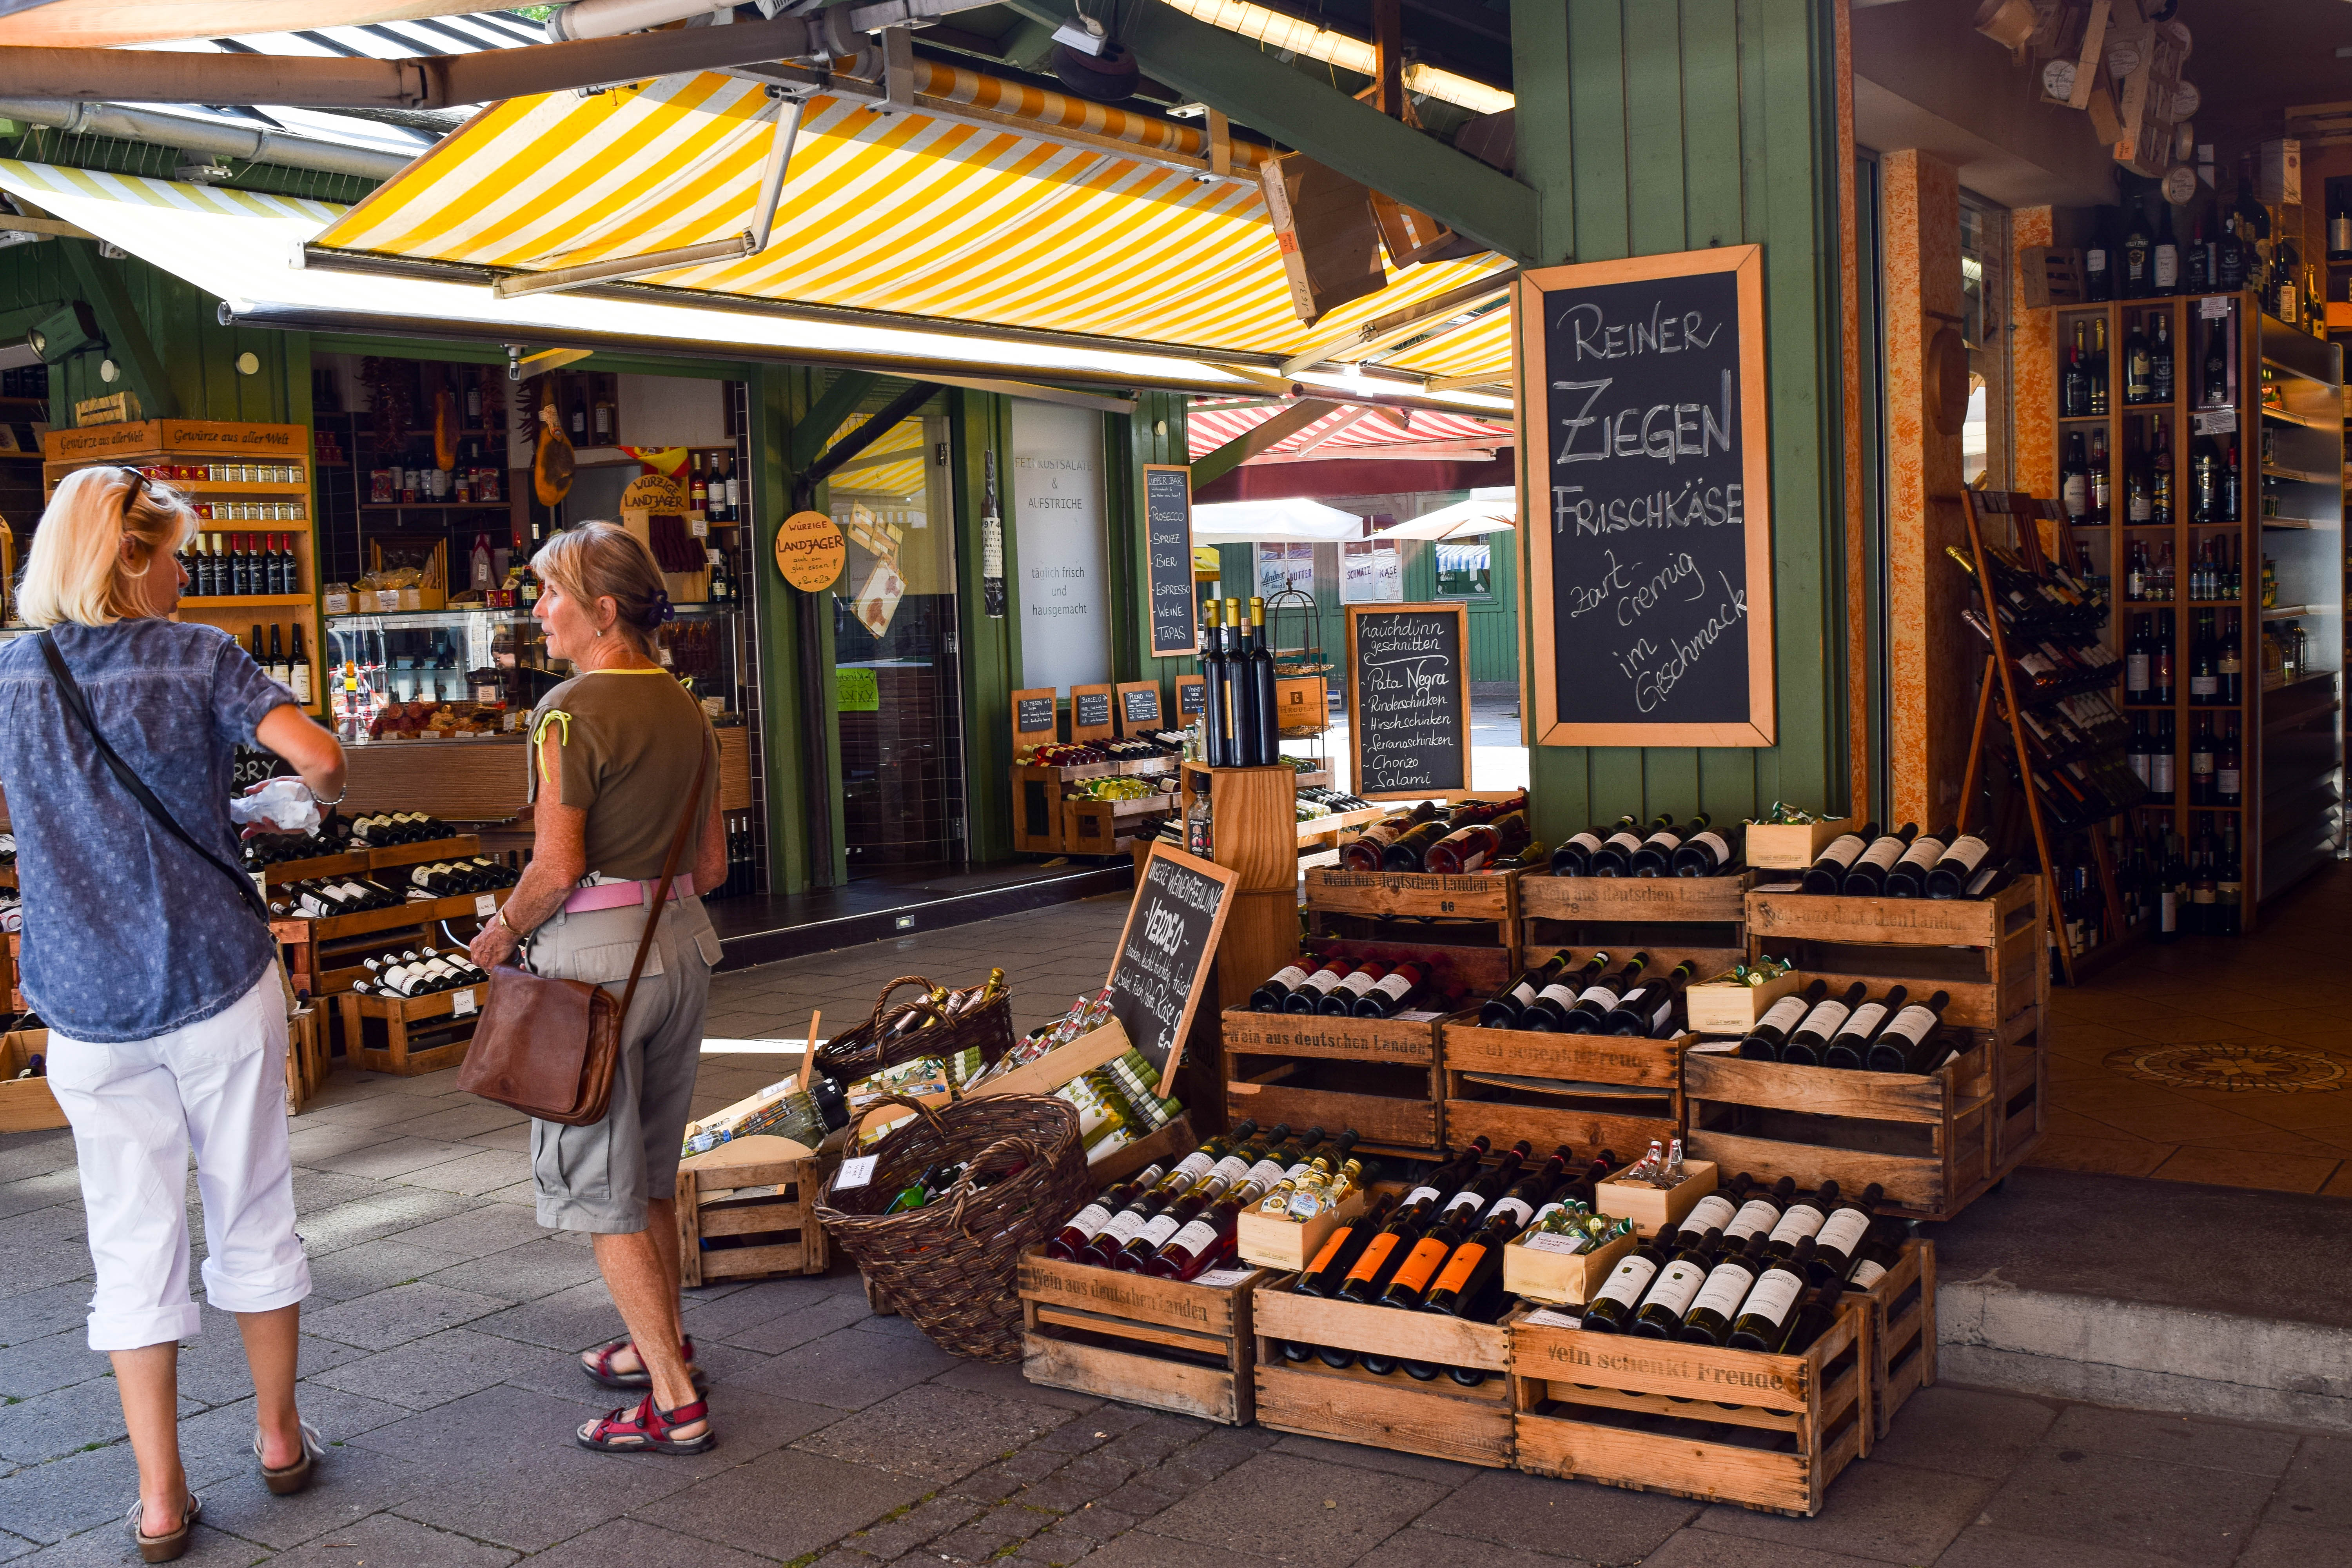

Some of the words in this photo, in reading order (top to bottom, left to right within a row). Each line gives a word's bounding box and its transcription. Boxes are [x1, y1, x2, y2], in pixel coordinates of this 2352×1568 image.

[1557, 300, 1721, 361] REINER
[61, 436, 98, 455] Gewürze
[98, 436, 109, 446] aus
[111, 432, 127, 444] aller
[126, 430, 144, 443] Welt
[174, 429, 218, 443] Gewürze
[221, 433, 239, 443] aus
[242, 431, 264, 444] aller
[265, 432, 289, 445] Welt
[633, 476, 679, 497] WÜRZIGE
[1052, 477, 1058, 489] &
[1148, 476, 1167, 485] LUPPER
[624, 491, 684, 509] LANDJÄGER
[1028, 498, 1082, 509] AUFSTRICHE
[1551, 477, 1742, 536] FRISCHKÄSE
[1151, 506, 1184, 521] PROSECCO
[789, 521, 827, 531] WÜRZIGE
[777, 535, 844, 554] LANDJÄGER
[1153, 532, 1181, 544] SPRIZZ
[791, 564, 804, 573] glei
[1153, 554, 1178, 568] BIER
[1032, 567, 1059, 581] täglich
[1062, 566, 1084, 578] frisch
[1289, 569, 1312, 581] BUTTER
[1052, 585, 1067, 596] und
[1156, 582, 1191, 596] ESPRESSO
[1033, 603, 1087, 617] hausgemacht
[1157, 601, 1185, 617] WEINE
[1157, 626, 1186, 641] TAPAS
[1360, 615, 1444, 638] hauchdünn
[1371, 635, 1441, 657] geschnitten
[1635, 571, 1748, 713] Geschmack
[1612, 638, 1657, 679] im
[1367, 667, 1403, 691] Pata
[1406, 660, 1449, 697] Negra
[1295, 694, 1299, 702] C
[1368, 692, 1448, 713] Rinderschinken
[1279, 704, 1314, 713] HECULA
[1370, 710, 1451, 730] Hirschschinken
[1367, 730, 1454, 753] Serranoschinken
[1372, 754, 1419, 770] Chorizo
[1372, 770, 1431, 789] Salami
[1148, 861, 1171, 886] UNSERE
[1323, 873, 1351, 886] Wein
[1354, 874, 1375, 887] aus
[1380, 874, 1440, 890] deutschen
[1443, 875, 1488, 892] Landen
[1145, 897, 1185, 956] VERDEO
[1172, 963, 1194, 1003] frisch
[1229, 1030, 1260, 1044] Wein
[1266, 1033, 1289, 1045] aus
[1295, 1032, 1368, 1049] deutschen
[1373, 1034, 1426, 1054] Landen
[1065, 1278, 1087, 1295] aus
[1597, 1354, 1690, 1379] schenkt
[1698, 1363, 1783, 1390] Freude
